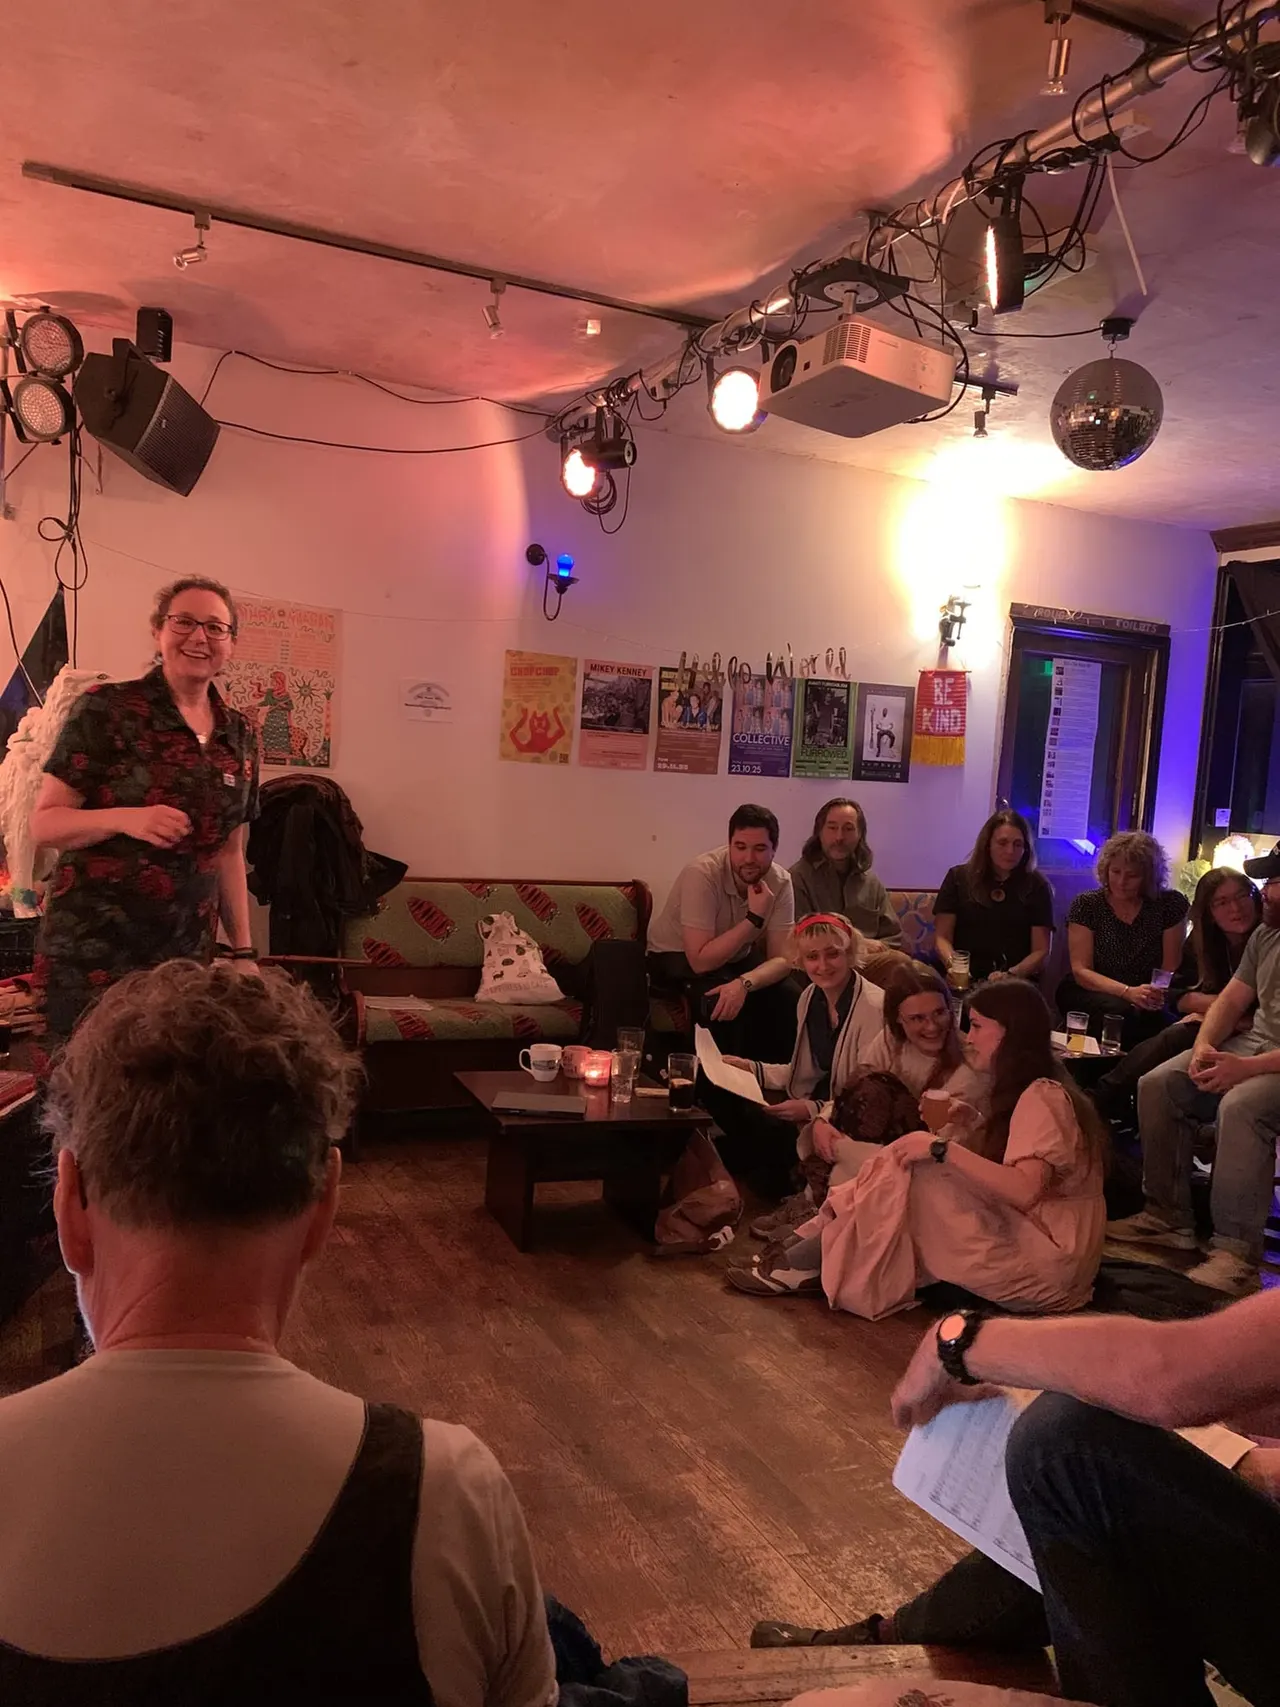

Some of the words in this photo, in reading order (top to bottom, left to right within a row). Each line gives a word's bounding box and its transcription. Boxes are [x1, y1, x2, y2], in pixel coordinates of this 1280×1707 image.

[590, 663, 615, 673] MIKEY
[617, 667, 647, 677] KENNEY
[678, 651, 752, 690] Hello
[766, 643, 851, 685] World
[934, 677, 955, 706] BE
[922, 708, 961, 733] KIND
[732, 732, 791, 746] COLLECTIVE
[800, 749, 848, 759] FURROWED
[731, 764, 762, 774] 23.10.25
